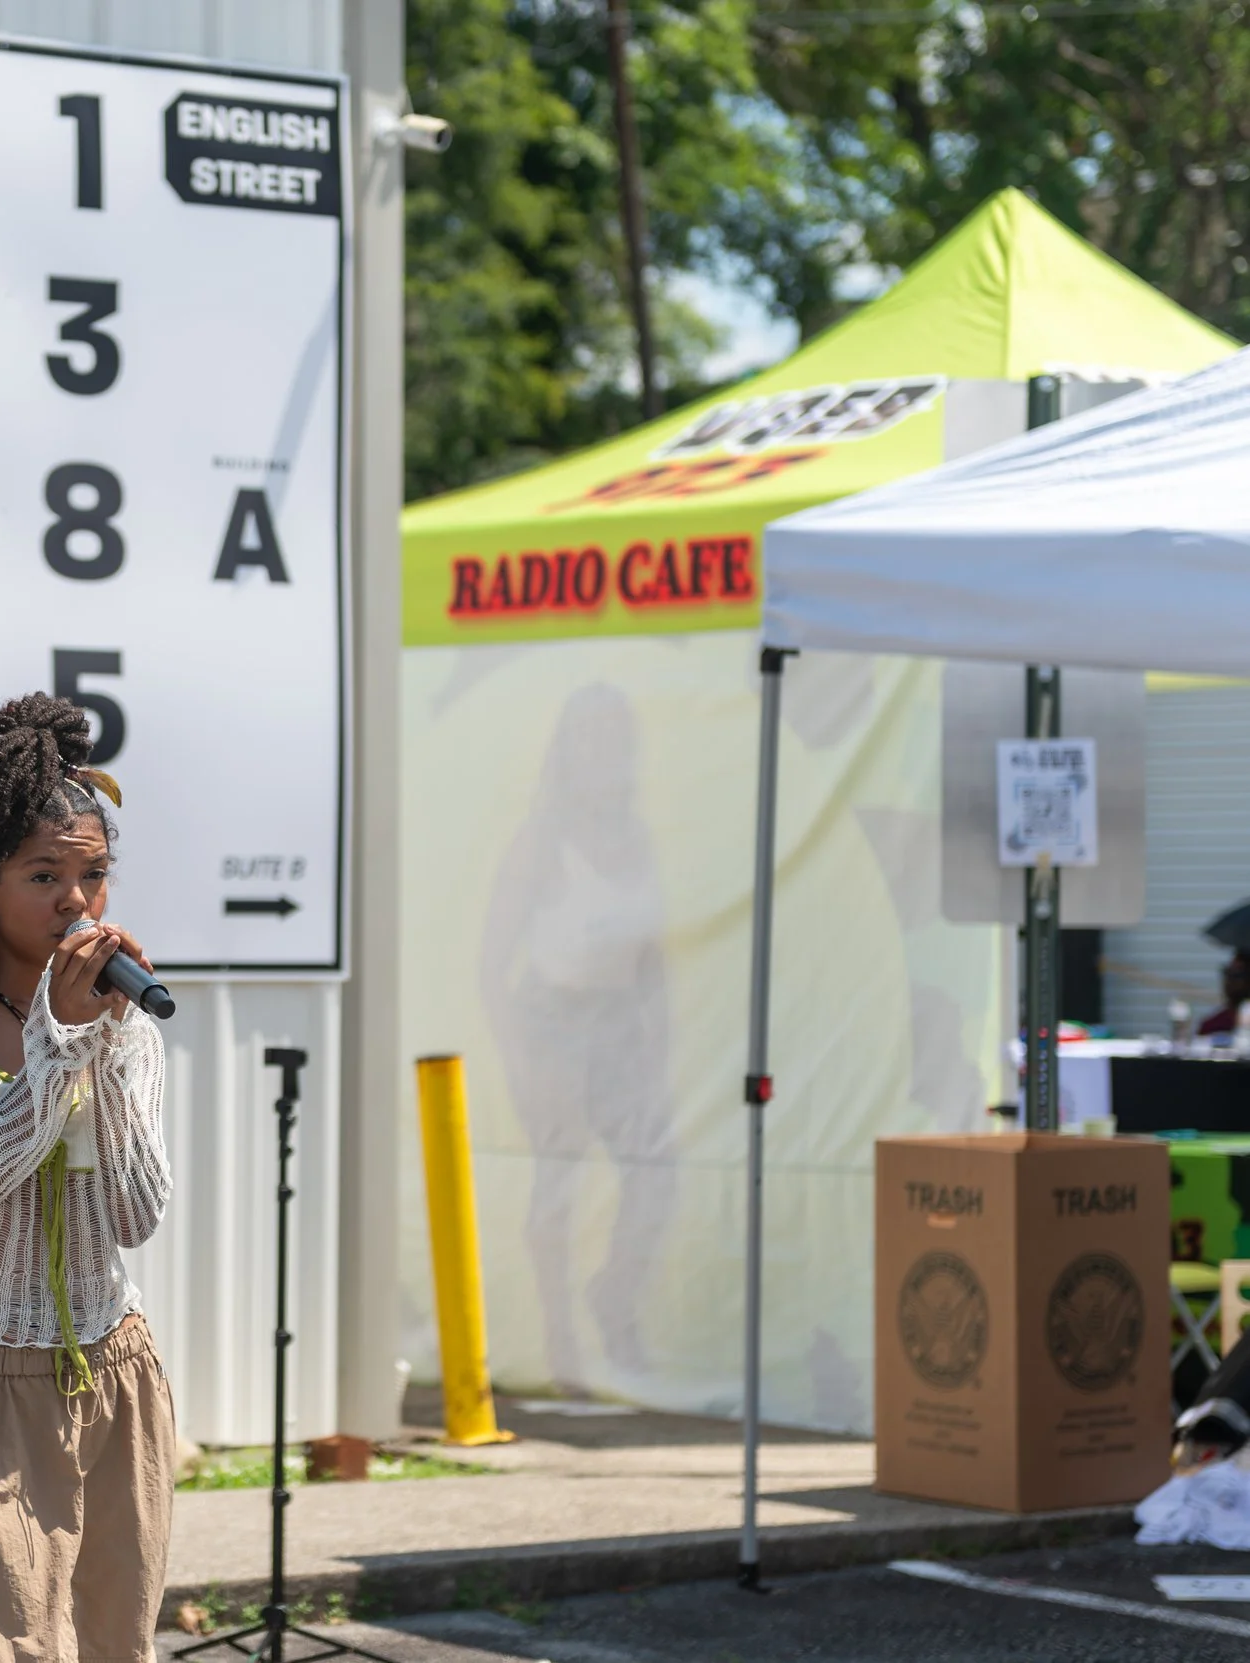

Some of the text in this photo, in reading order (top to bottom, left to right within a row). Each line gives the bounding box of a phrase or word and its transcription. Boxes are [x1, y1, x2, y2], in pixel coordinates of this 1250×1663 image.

[176, 100, 332, 154] ENGLISH
[188, 156, 324, 206] STREET
[211, 486, 292, 584] A
[448, 535, 754, 617] RADIO CAFE
[904, 1180, 984, 1218] TRASH
[1052, 1184, 1138, 1218] TRASH
